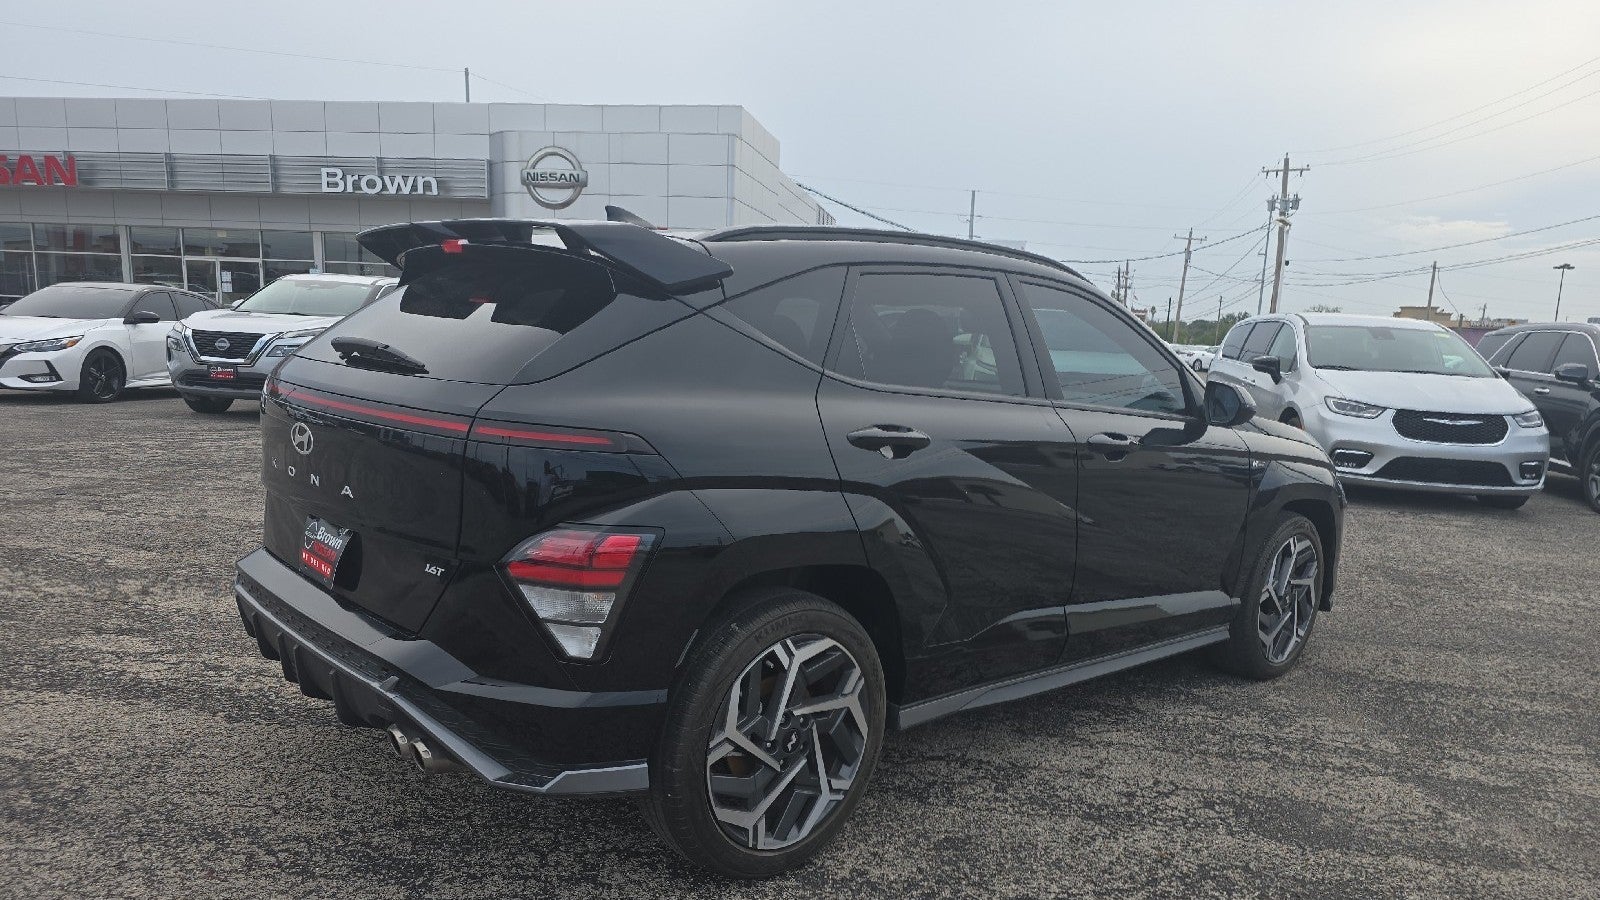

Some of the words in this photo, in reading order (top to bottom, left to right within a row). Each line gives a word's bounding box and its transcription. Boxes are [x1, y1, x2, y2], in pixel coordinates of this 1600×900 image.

[320, 167, 440, 196] Brown
[526, 172, 580, 183] NISSAN
[316, 526, 343, 549] Brown
